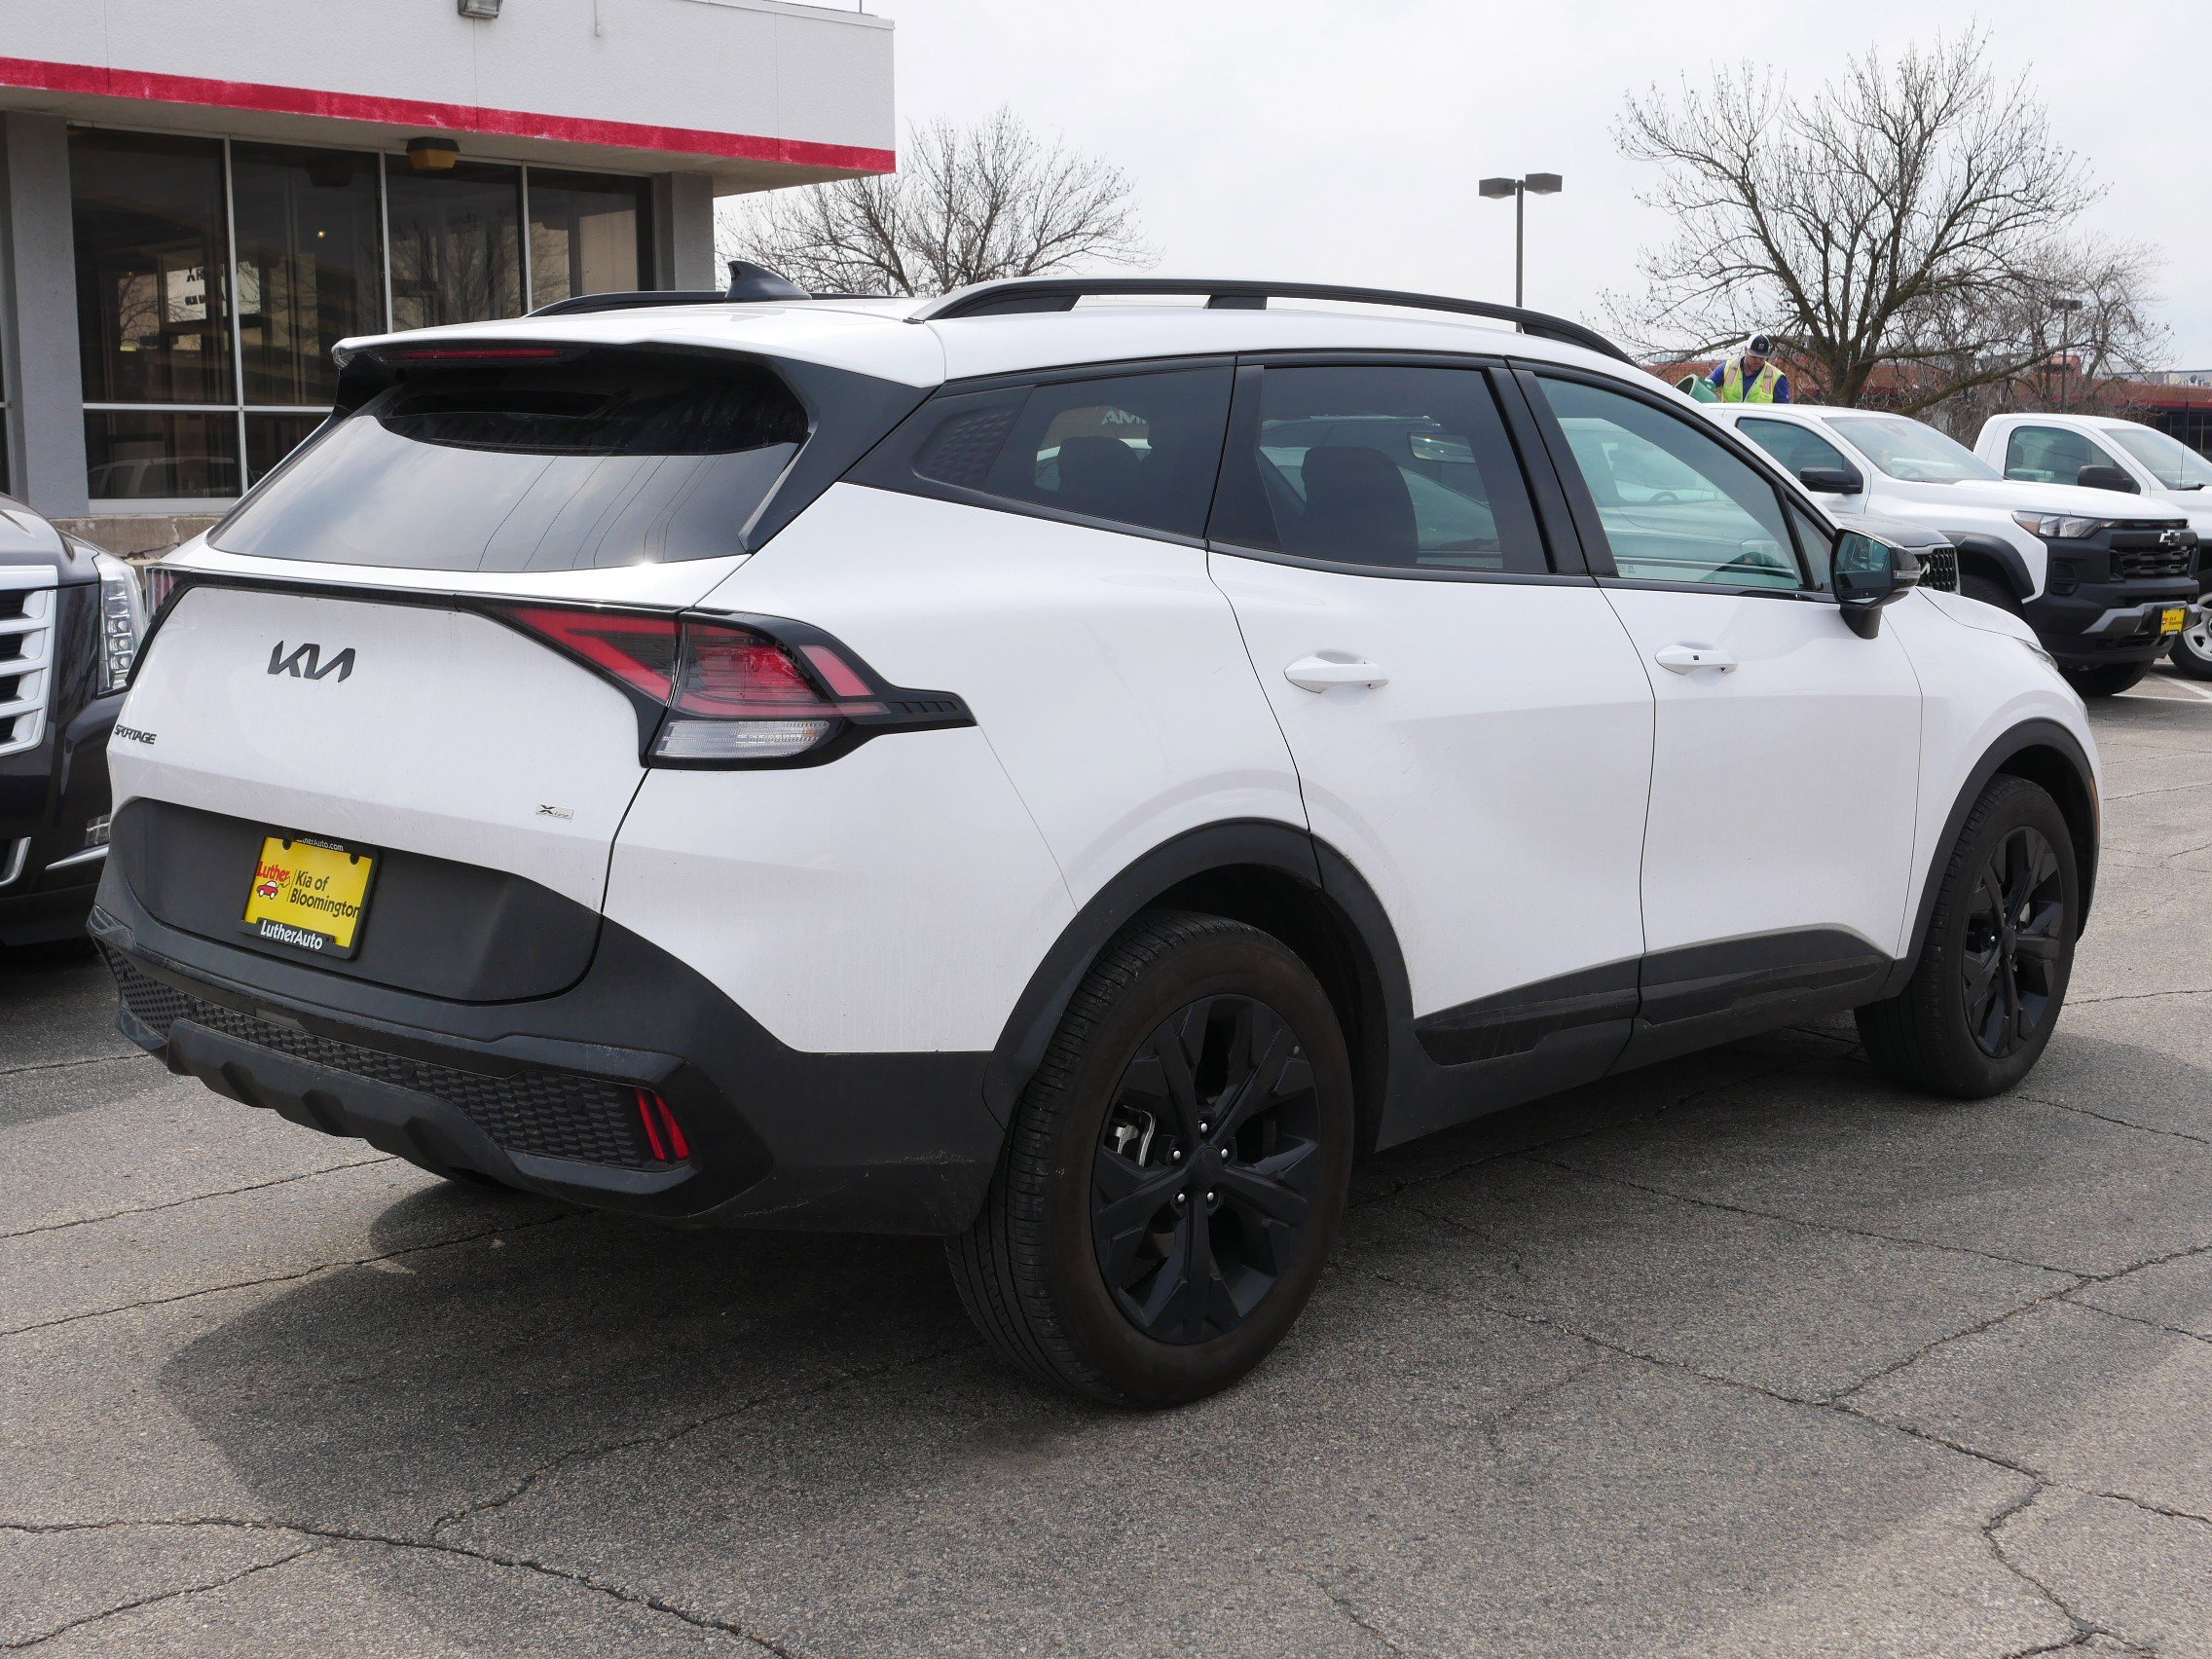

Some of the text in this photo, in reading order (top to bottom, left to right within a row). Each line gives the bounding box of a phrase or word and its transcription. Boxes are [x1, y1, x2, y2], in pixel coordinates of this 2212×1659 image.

[267, 640, 355, 682] KIA
[114, 723, 157, 745] SPORTAGE
[257, 861, 290, 882] Luther
[295, 870, 330, 891] Kia of
[289, 888, 361, 918] Bloomington
[260, 920, 323, 950] LutherAuto
